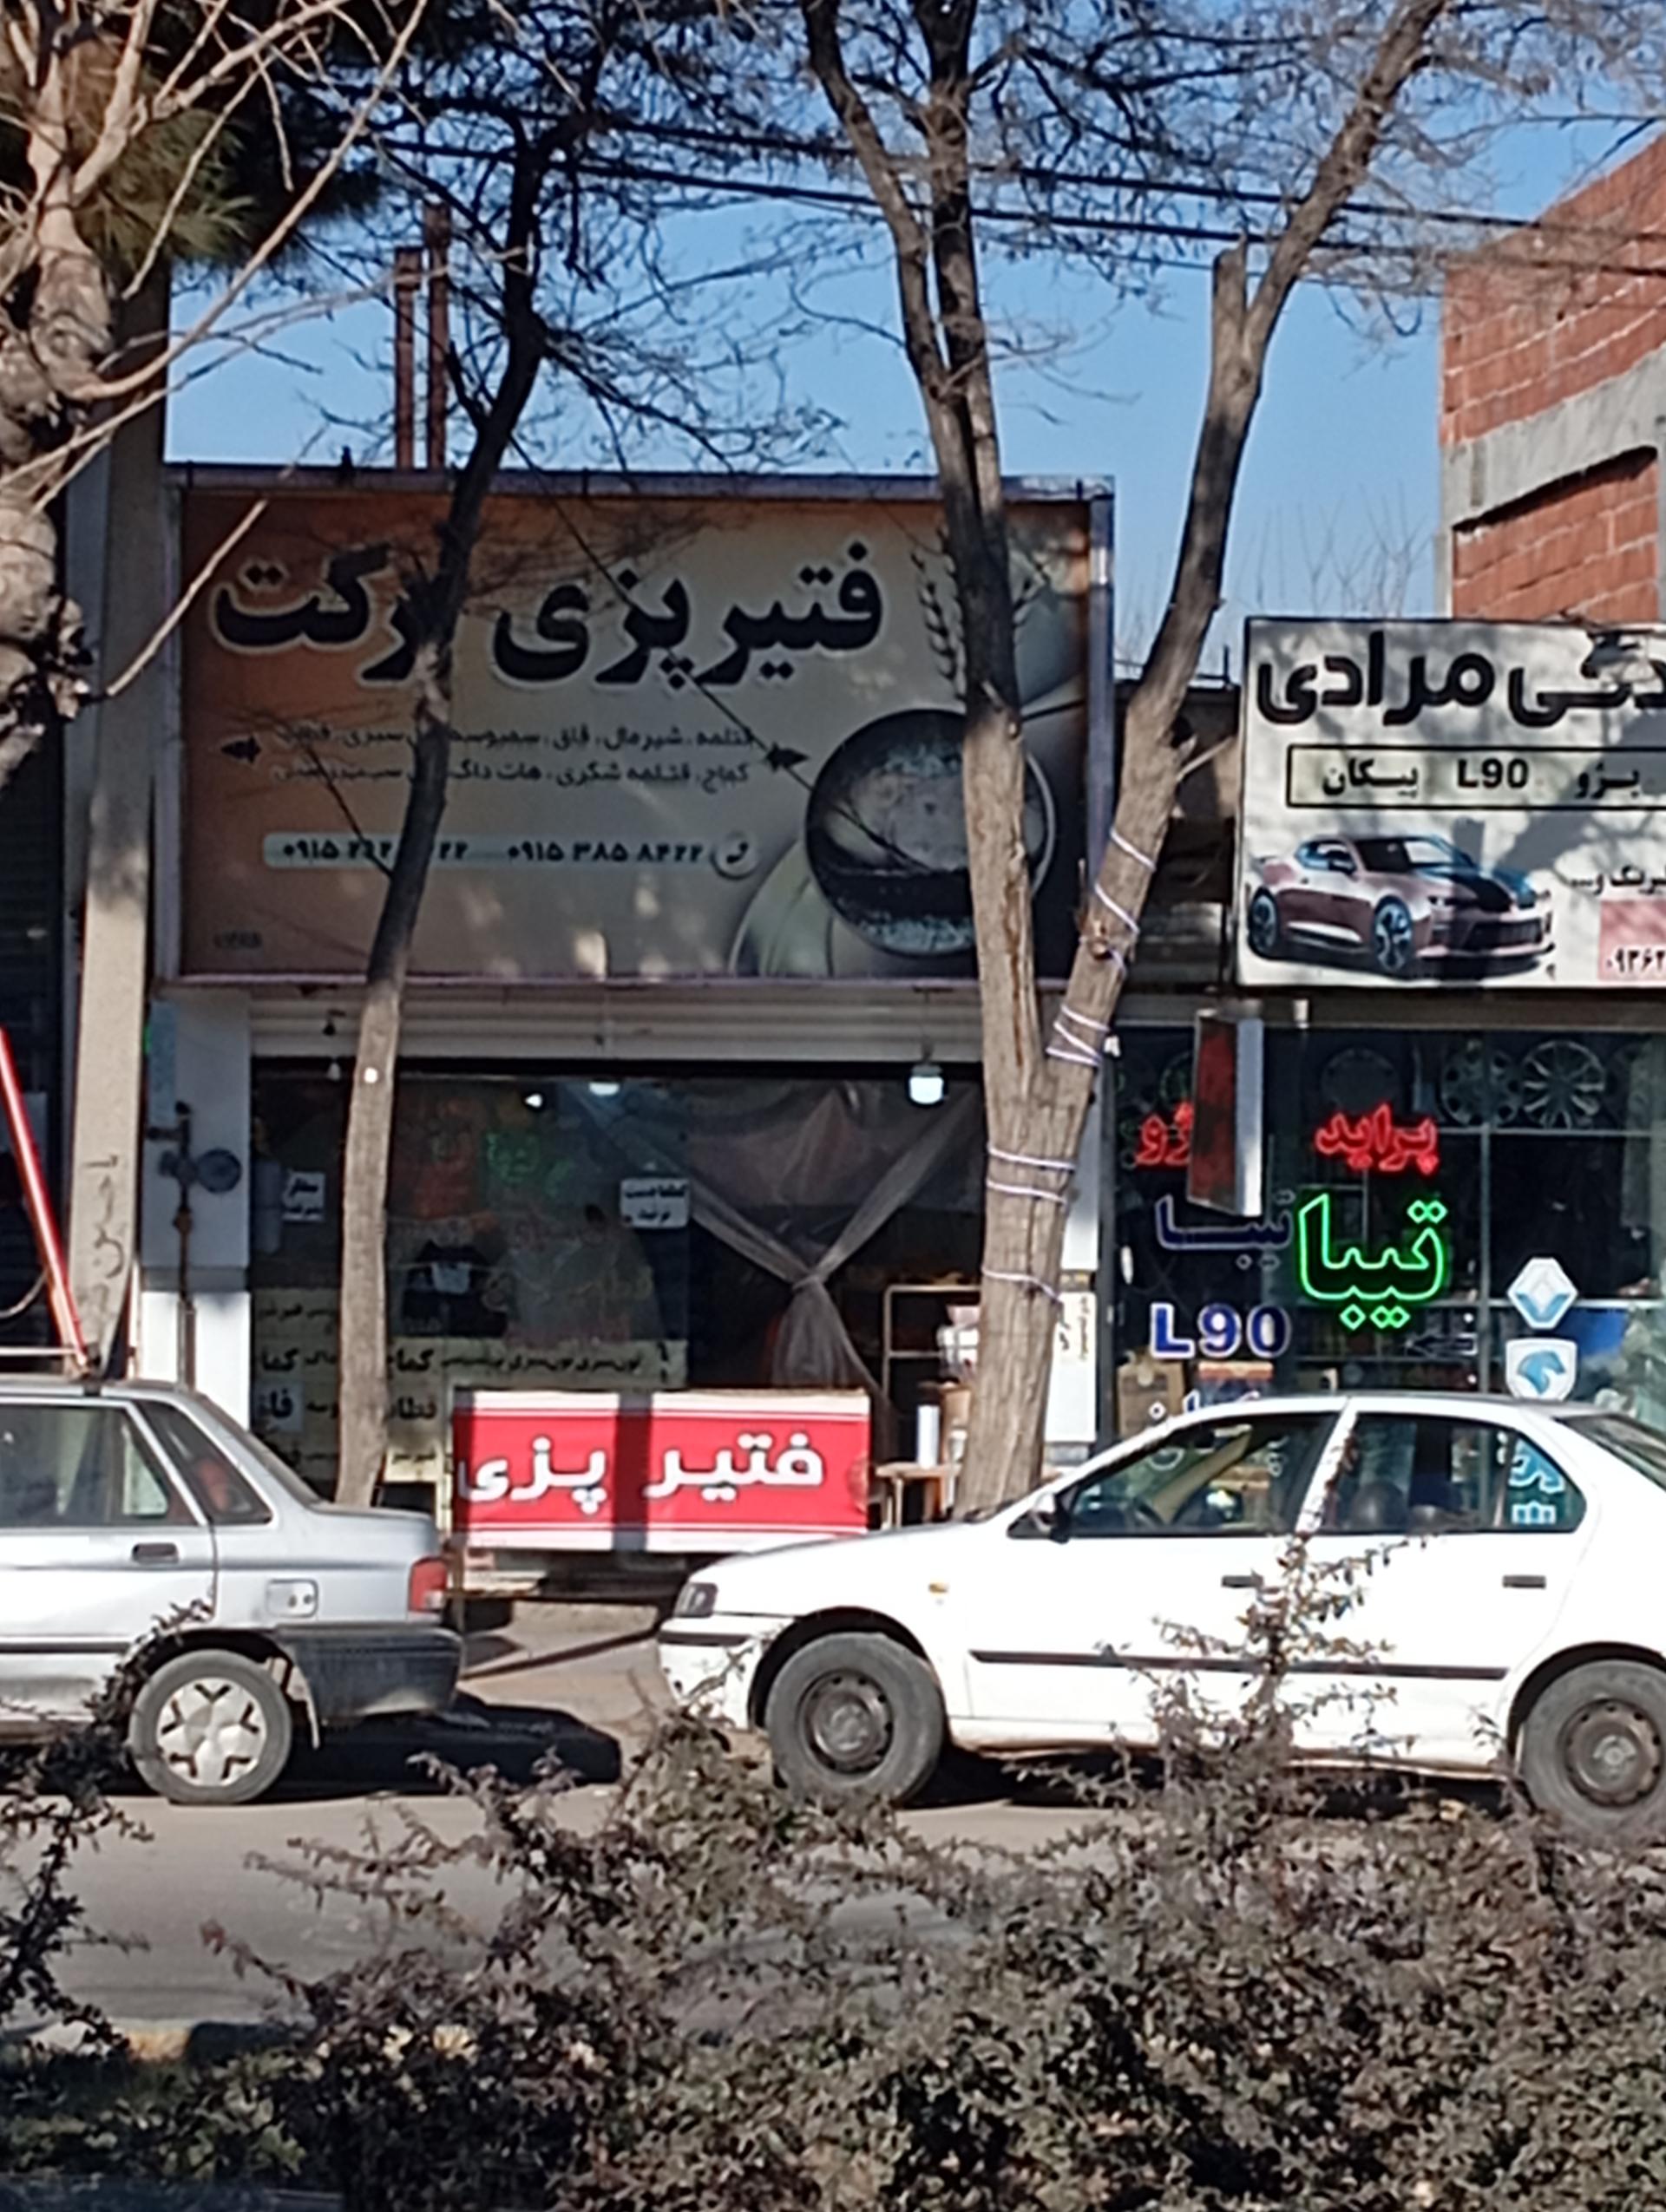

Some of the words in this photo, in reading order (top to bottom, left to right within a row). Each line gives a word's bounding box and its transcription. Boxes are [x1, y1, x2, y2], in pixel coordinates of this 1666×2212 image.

[213, 542, 421, 682] رکت
[1256, 631, 1496, 726] مرادی
[1322, 757, 1419, 800] پیکان
[1458, 758, 1529, 789] L90
[1315, 1103, 1440, 1176] پراید
[1299, 1192, 1448, 1331] تیبا
[1149, 1302, 1293, 1359] L90
[457, 1436, 607, 1515] پزی
[643, 1432, 823, 1503] فتیر
